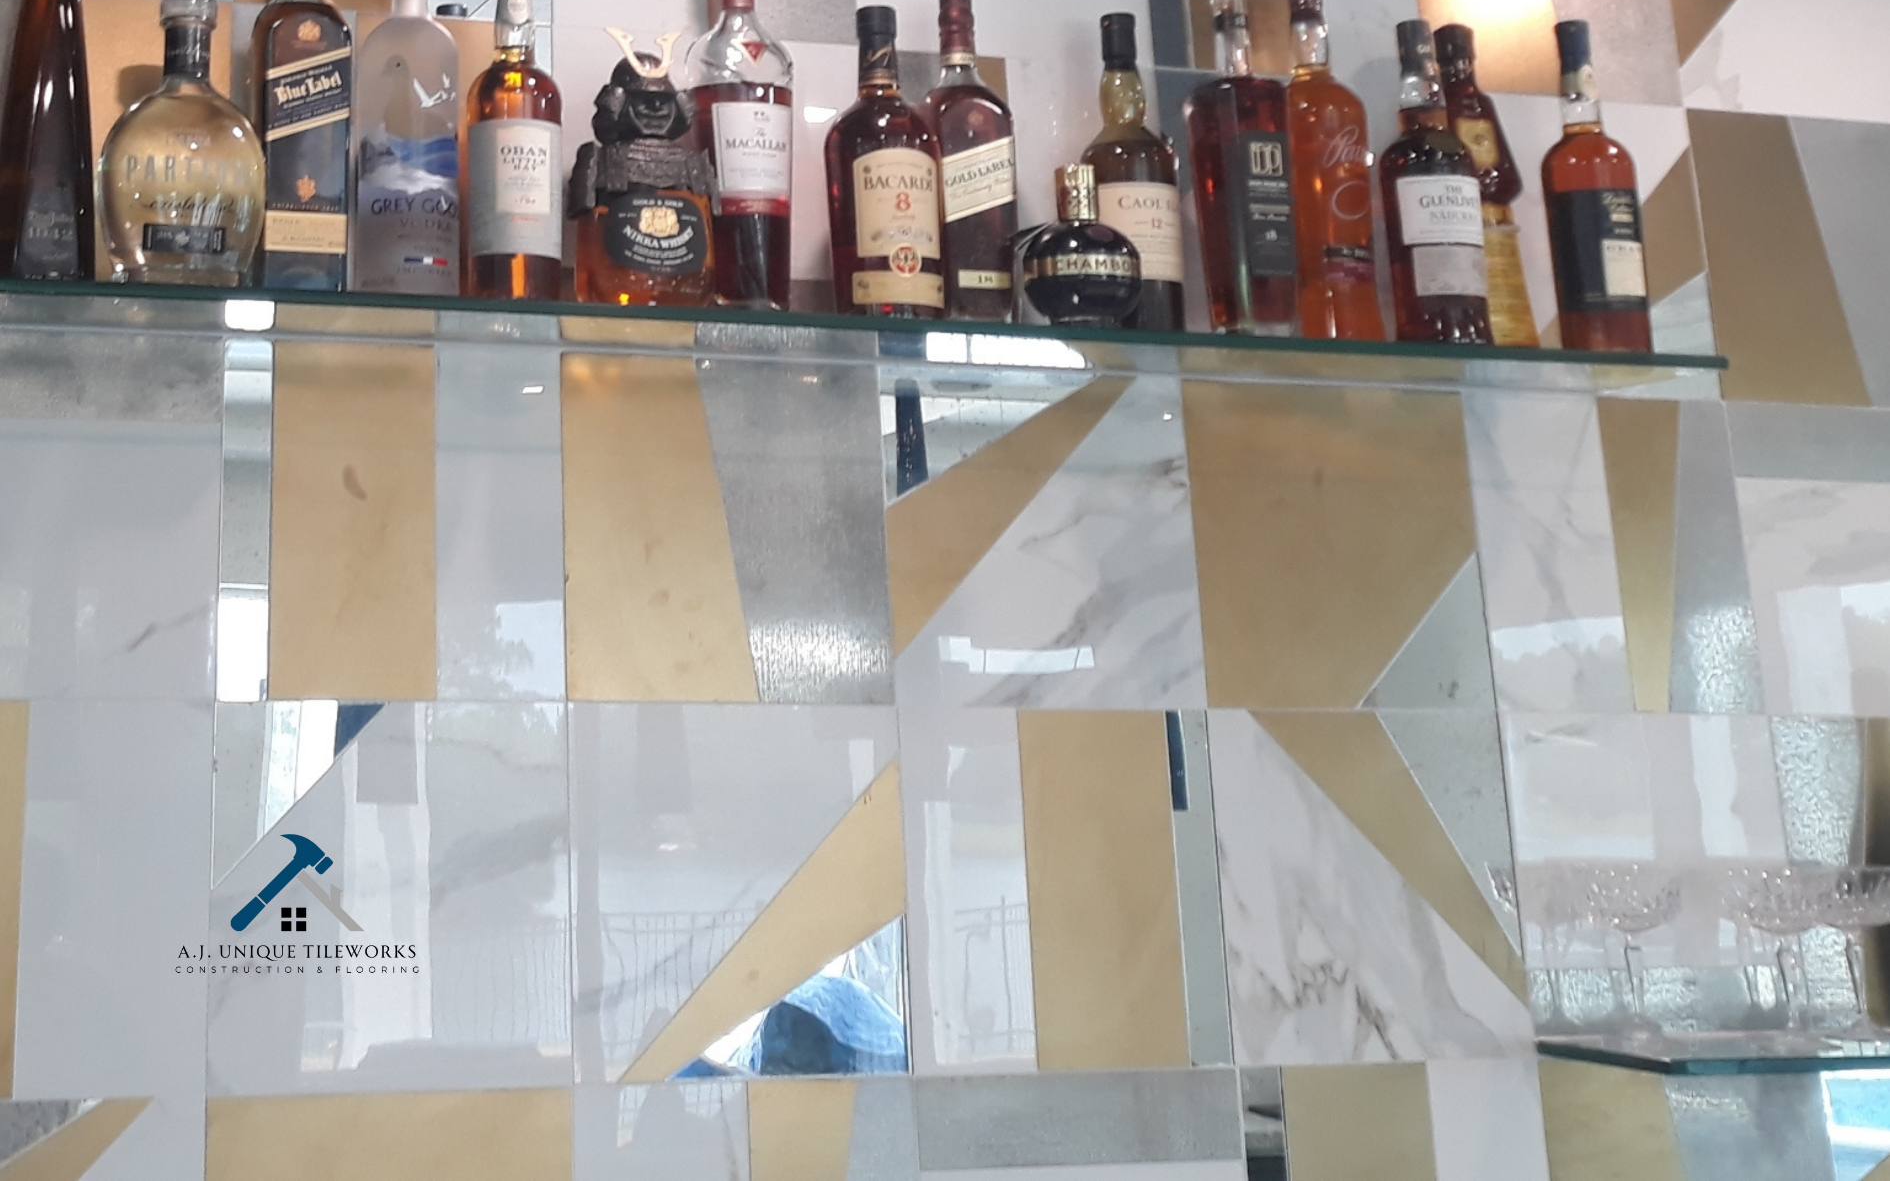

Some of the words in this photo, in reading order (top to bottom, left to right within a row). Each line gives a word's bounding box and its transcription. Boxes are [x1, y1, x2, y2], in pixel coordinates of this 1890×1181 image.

[500, 145, 547, 157] OBAN
[726, 138, 787, 151] MACALLAN
[864, 175, 933, 191] BACARDI
[945, 170, 977, 189] GOLD
[371, 198, 415, 215] GREY
[895, 191, 911, 212] 8
